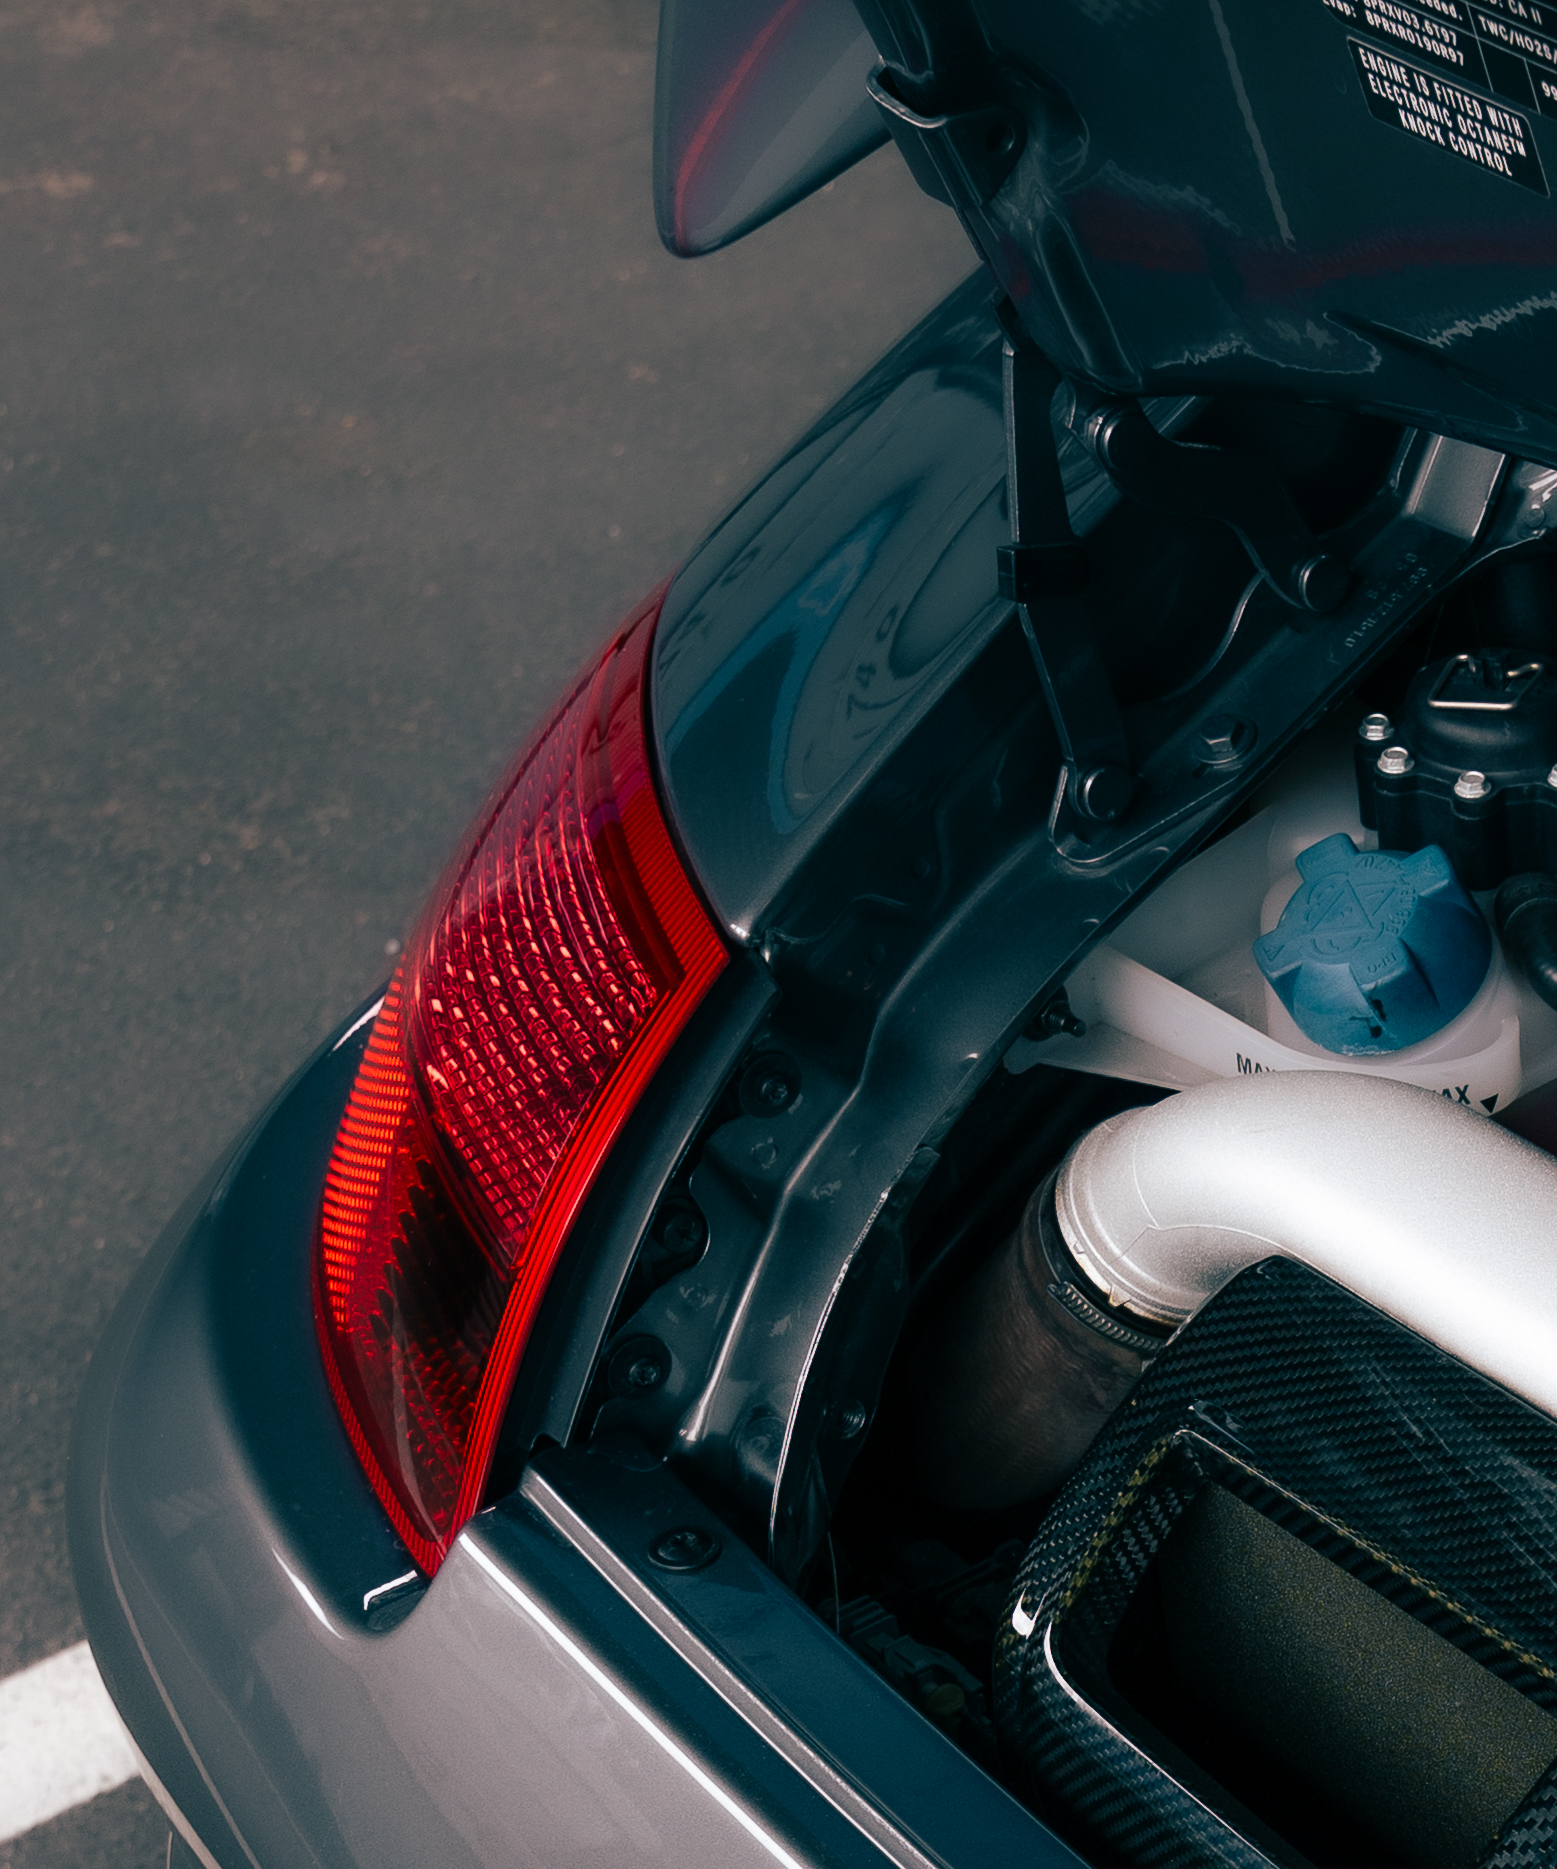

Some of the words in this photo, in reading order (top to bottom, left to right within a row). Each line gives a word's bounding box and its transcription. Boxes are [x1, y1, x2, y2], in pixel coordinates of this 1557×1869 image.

[1358, 46, 1411, 88] ENGINE
[1413, 71, 1430, 96] IS
[1432, 80, 1483, 121] FITTED
[1485, 104, 1524, 139] WITH
[1367, 72, 1453, 128] ELECTRONIC
[1398, 107, 1446, 147] KNOCK
[1448, 131, 1513, 177] CONTROL
[1236, 1052, 1277, 1076] MA
[1432, 1084, 1471, 1106] AX
